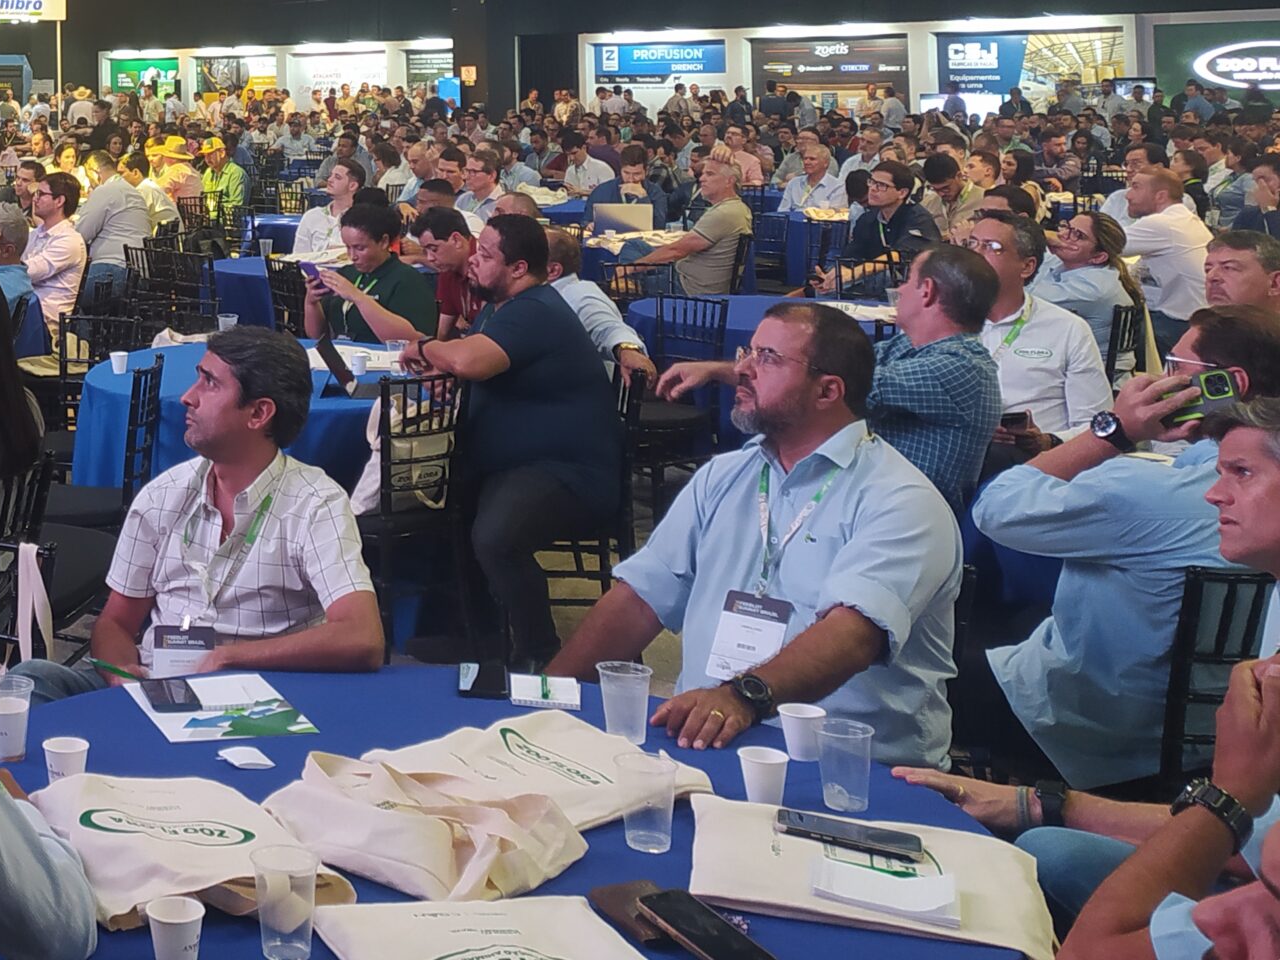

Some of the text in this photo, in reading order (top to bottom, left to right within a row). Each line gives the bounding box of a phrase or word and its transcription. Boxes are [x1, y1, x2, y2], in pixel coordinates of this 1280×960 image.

[632, 48, 703, 60] PROFUSION
[814, 42, 850, 57] zoetis
[671, 63, 704, 71] DRENCH
[182, 826, 231, 839] ZOO
